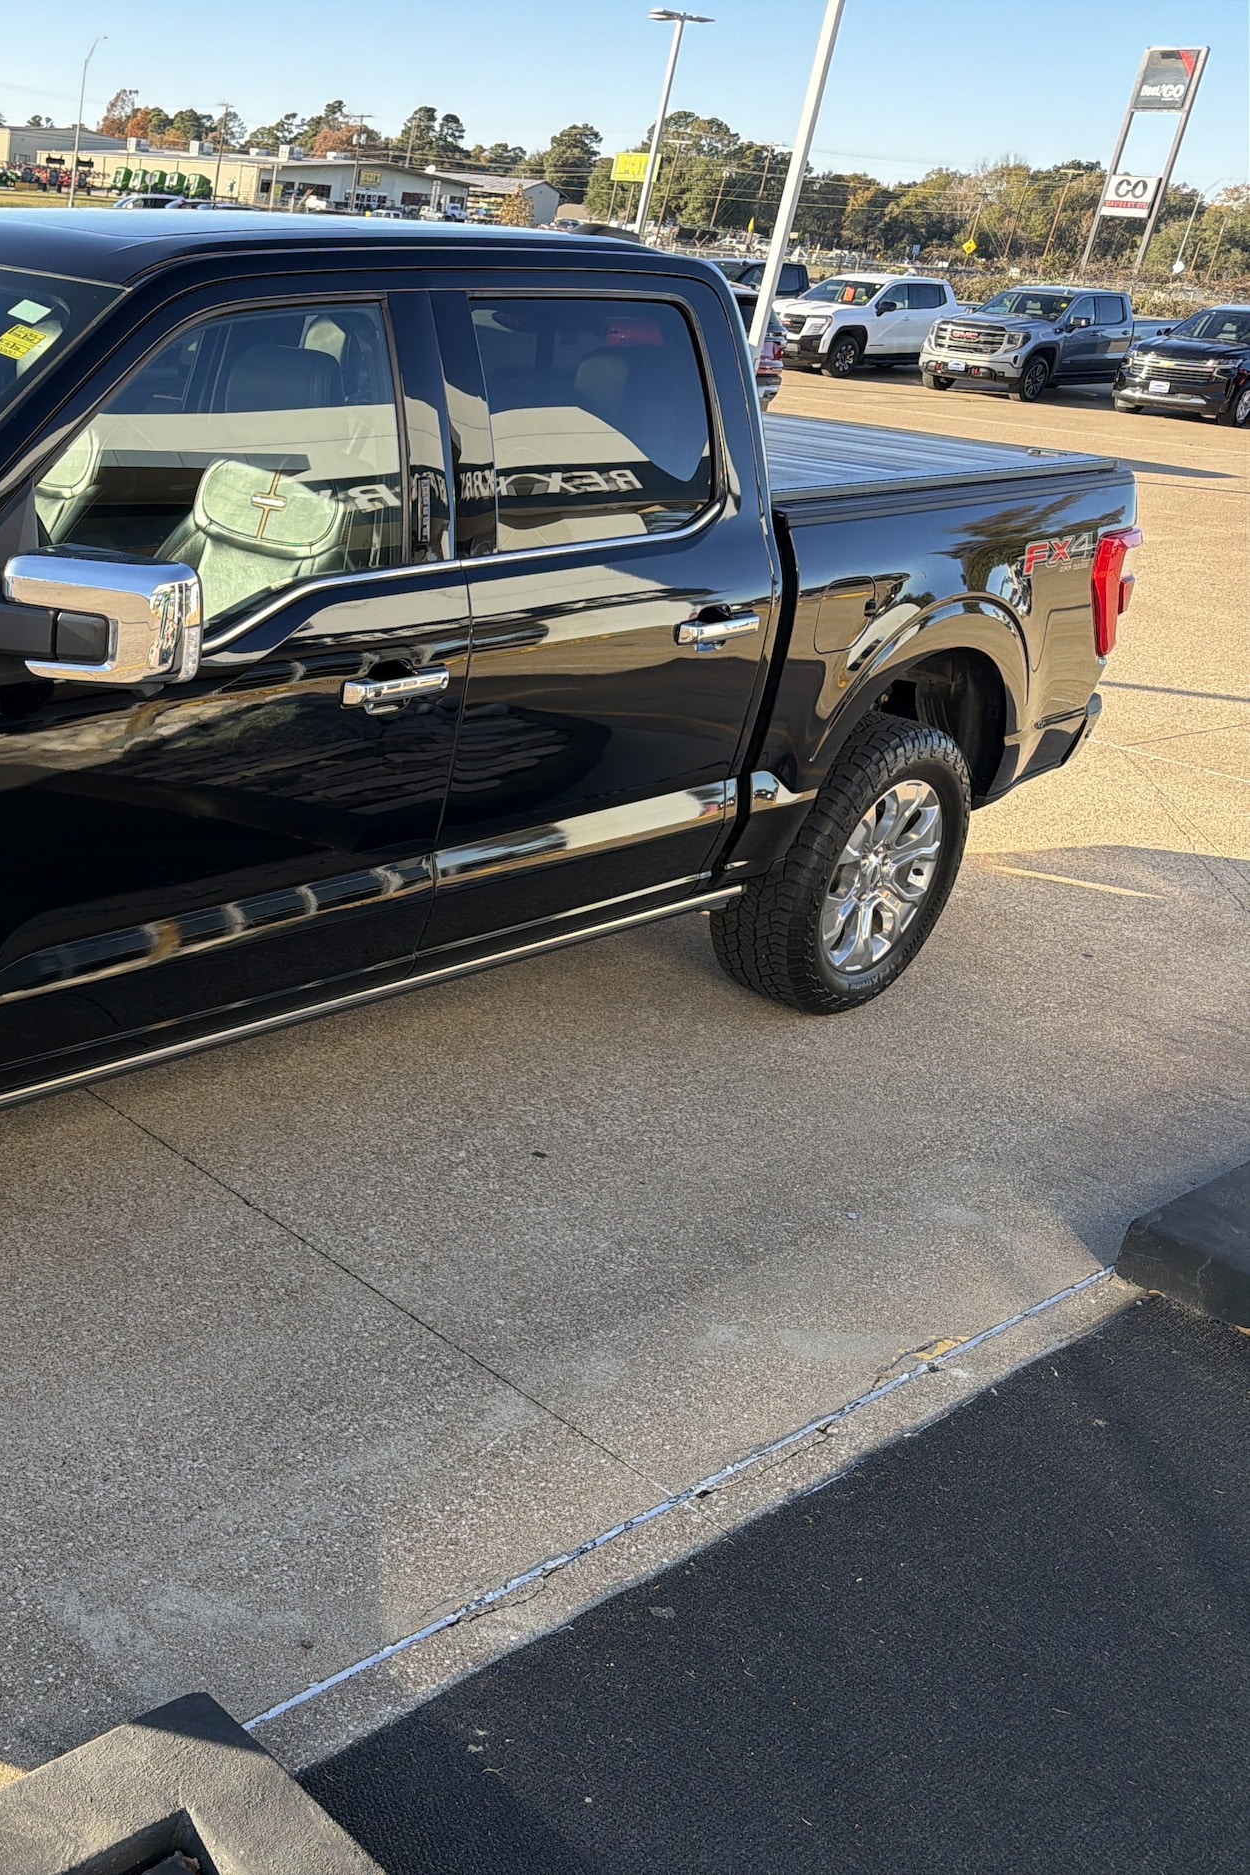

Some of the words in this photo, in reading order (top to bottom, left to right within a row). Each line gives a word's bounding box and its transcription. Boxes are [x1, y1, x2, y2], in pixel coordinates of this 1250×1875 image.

[1115, 179, 1148, 199] CO
[952, 330, 979, 341] GMC
[1023, 532, 1097, 579] FX4
